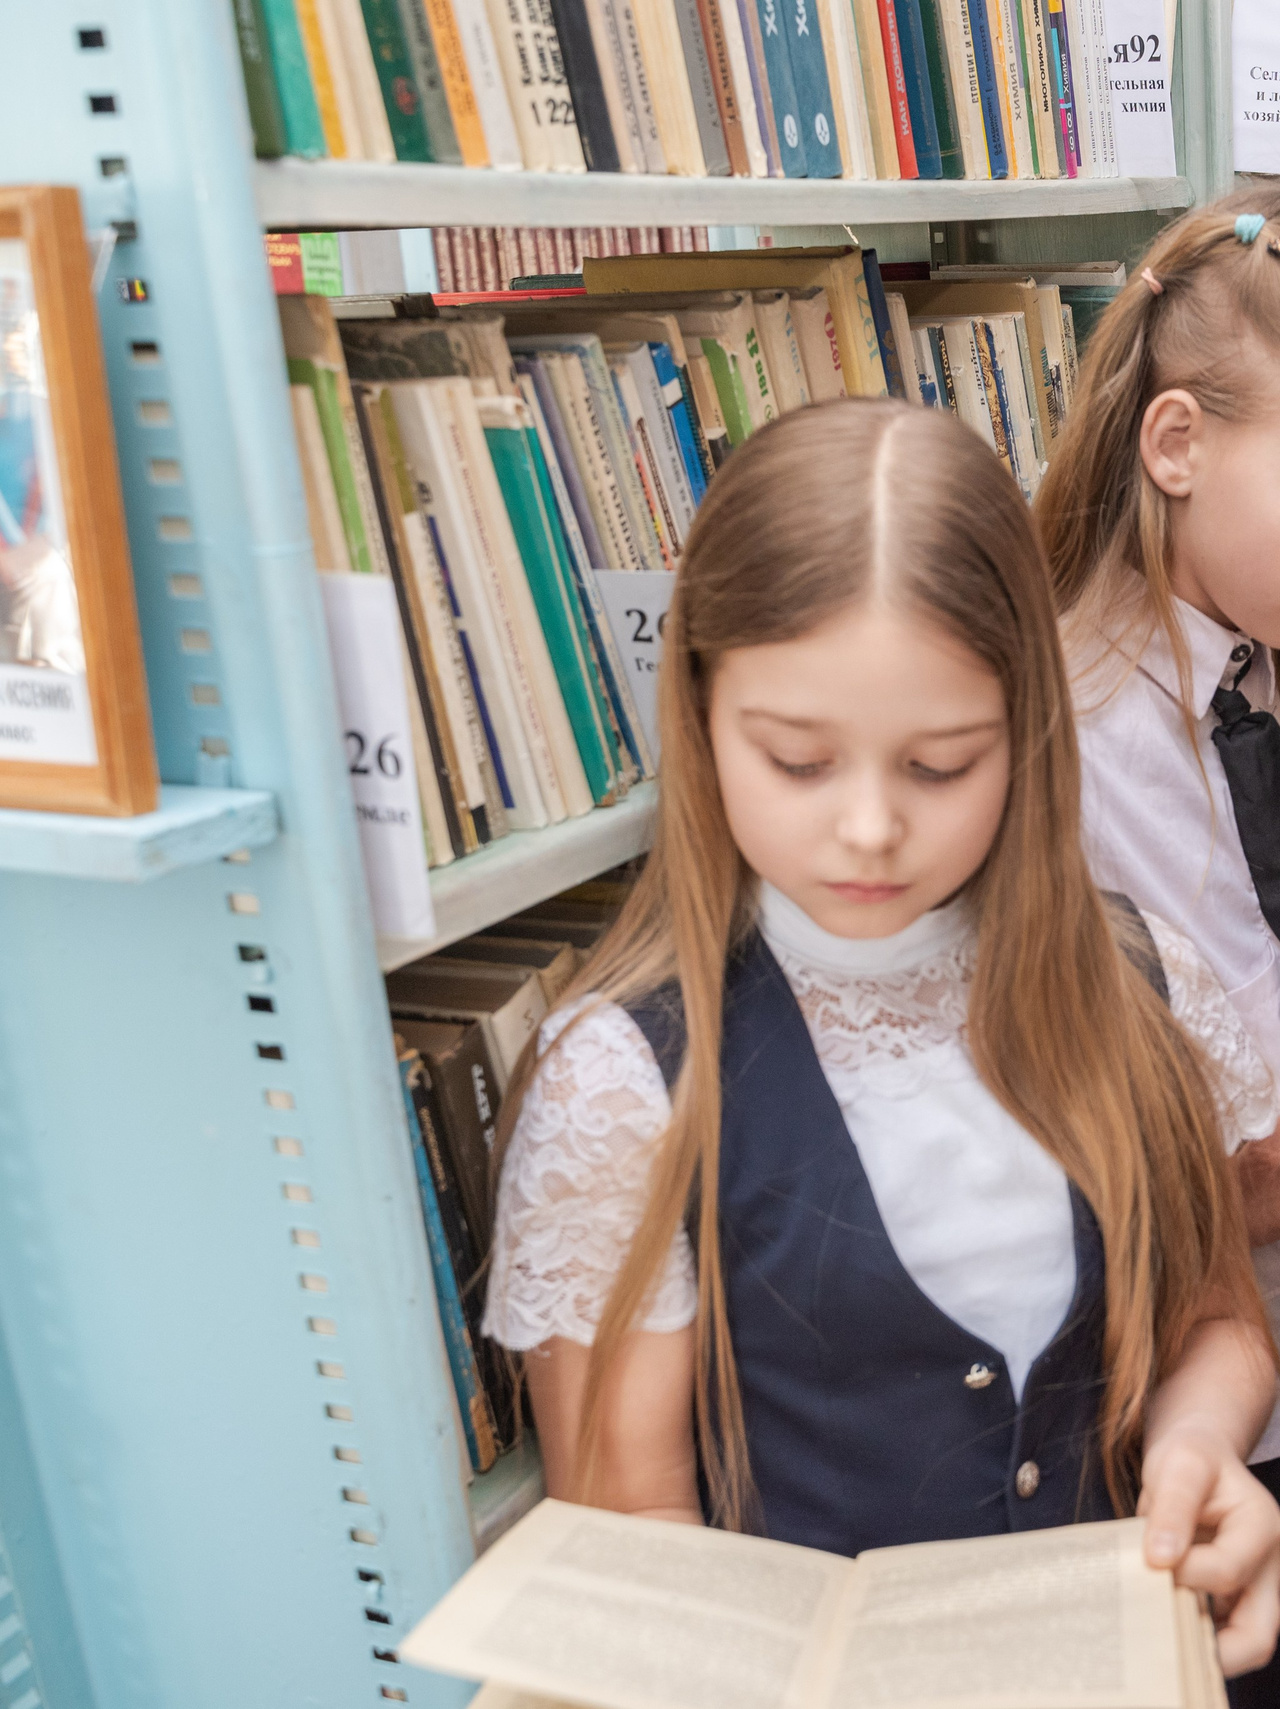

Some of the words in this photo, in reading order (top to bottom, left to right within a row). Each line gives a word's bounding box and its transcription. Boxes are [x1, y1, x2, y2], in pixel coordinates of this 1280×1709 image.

[1008, 63, 1022, 120] ХИМИЯ
[1036, 33, 1050, 113] МНОГОЛИКАЯ
[1121, 102, 1166, 113] химия
[1256, 91, 1265, 102] и
[896, 101, 910, 136] КАК
[940, 339, 951, 376] ГОРЫ
[344, 729, 401, 781] 26
